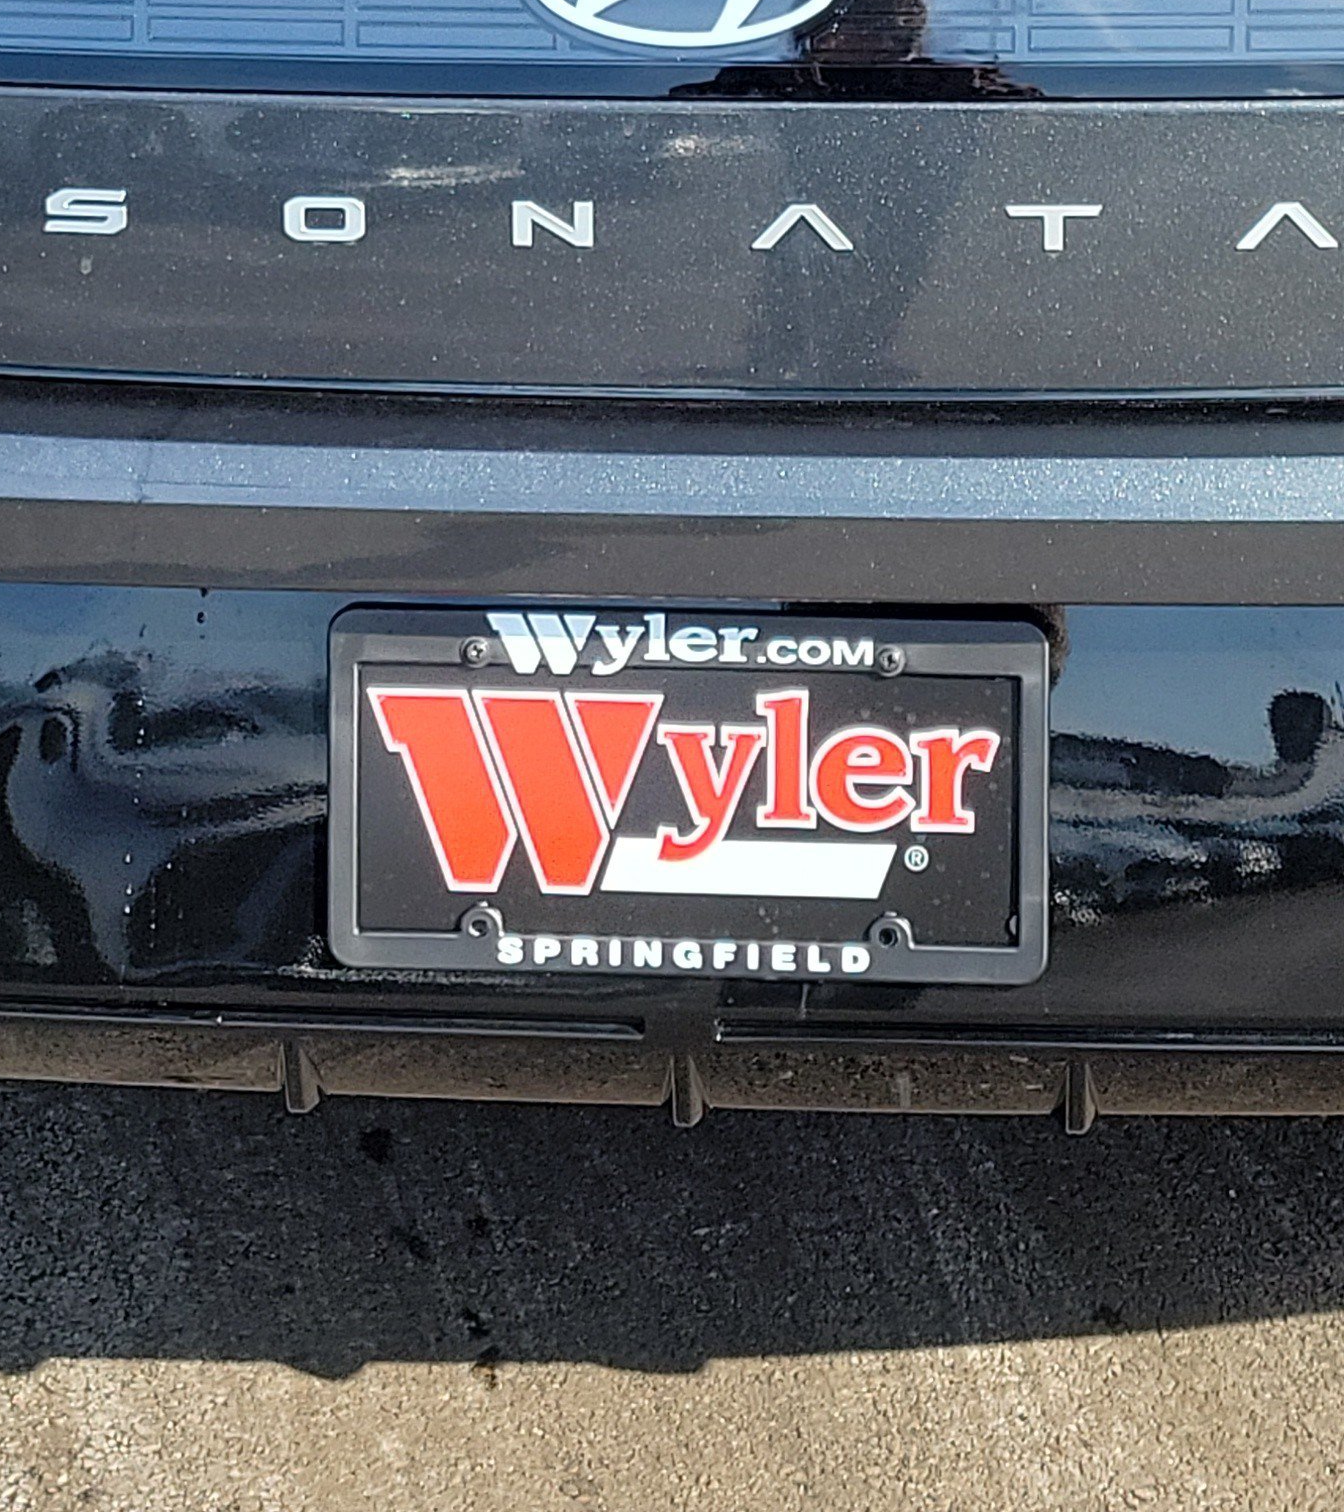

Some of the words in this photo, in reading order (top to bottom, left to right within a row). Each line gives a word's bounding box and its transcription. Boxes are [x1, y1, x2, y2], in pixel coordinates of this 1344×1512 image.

[44, 188, 1340, 252] SONATA
[367, 687, 1000, 895] Wyler
[497, 936, 871, 974] SPRINGFIELD
